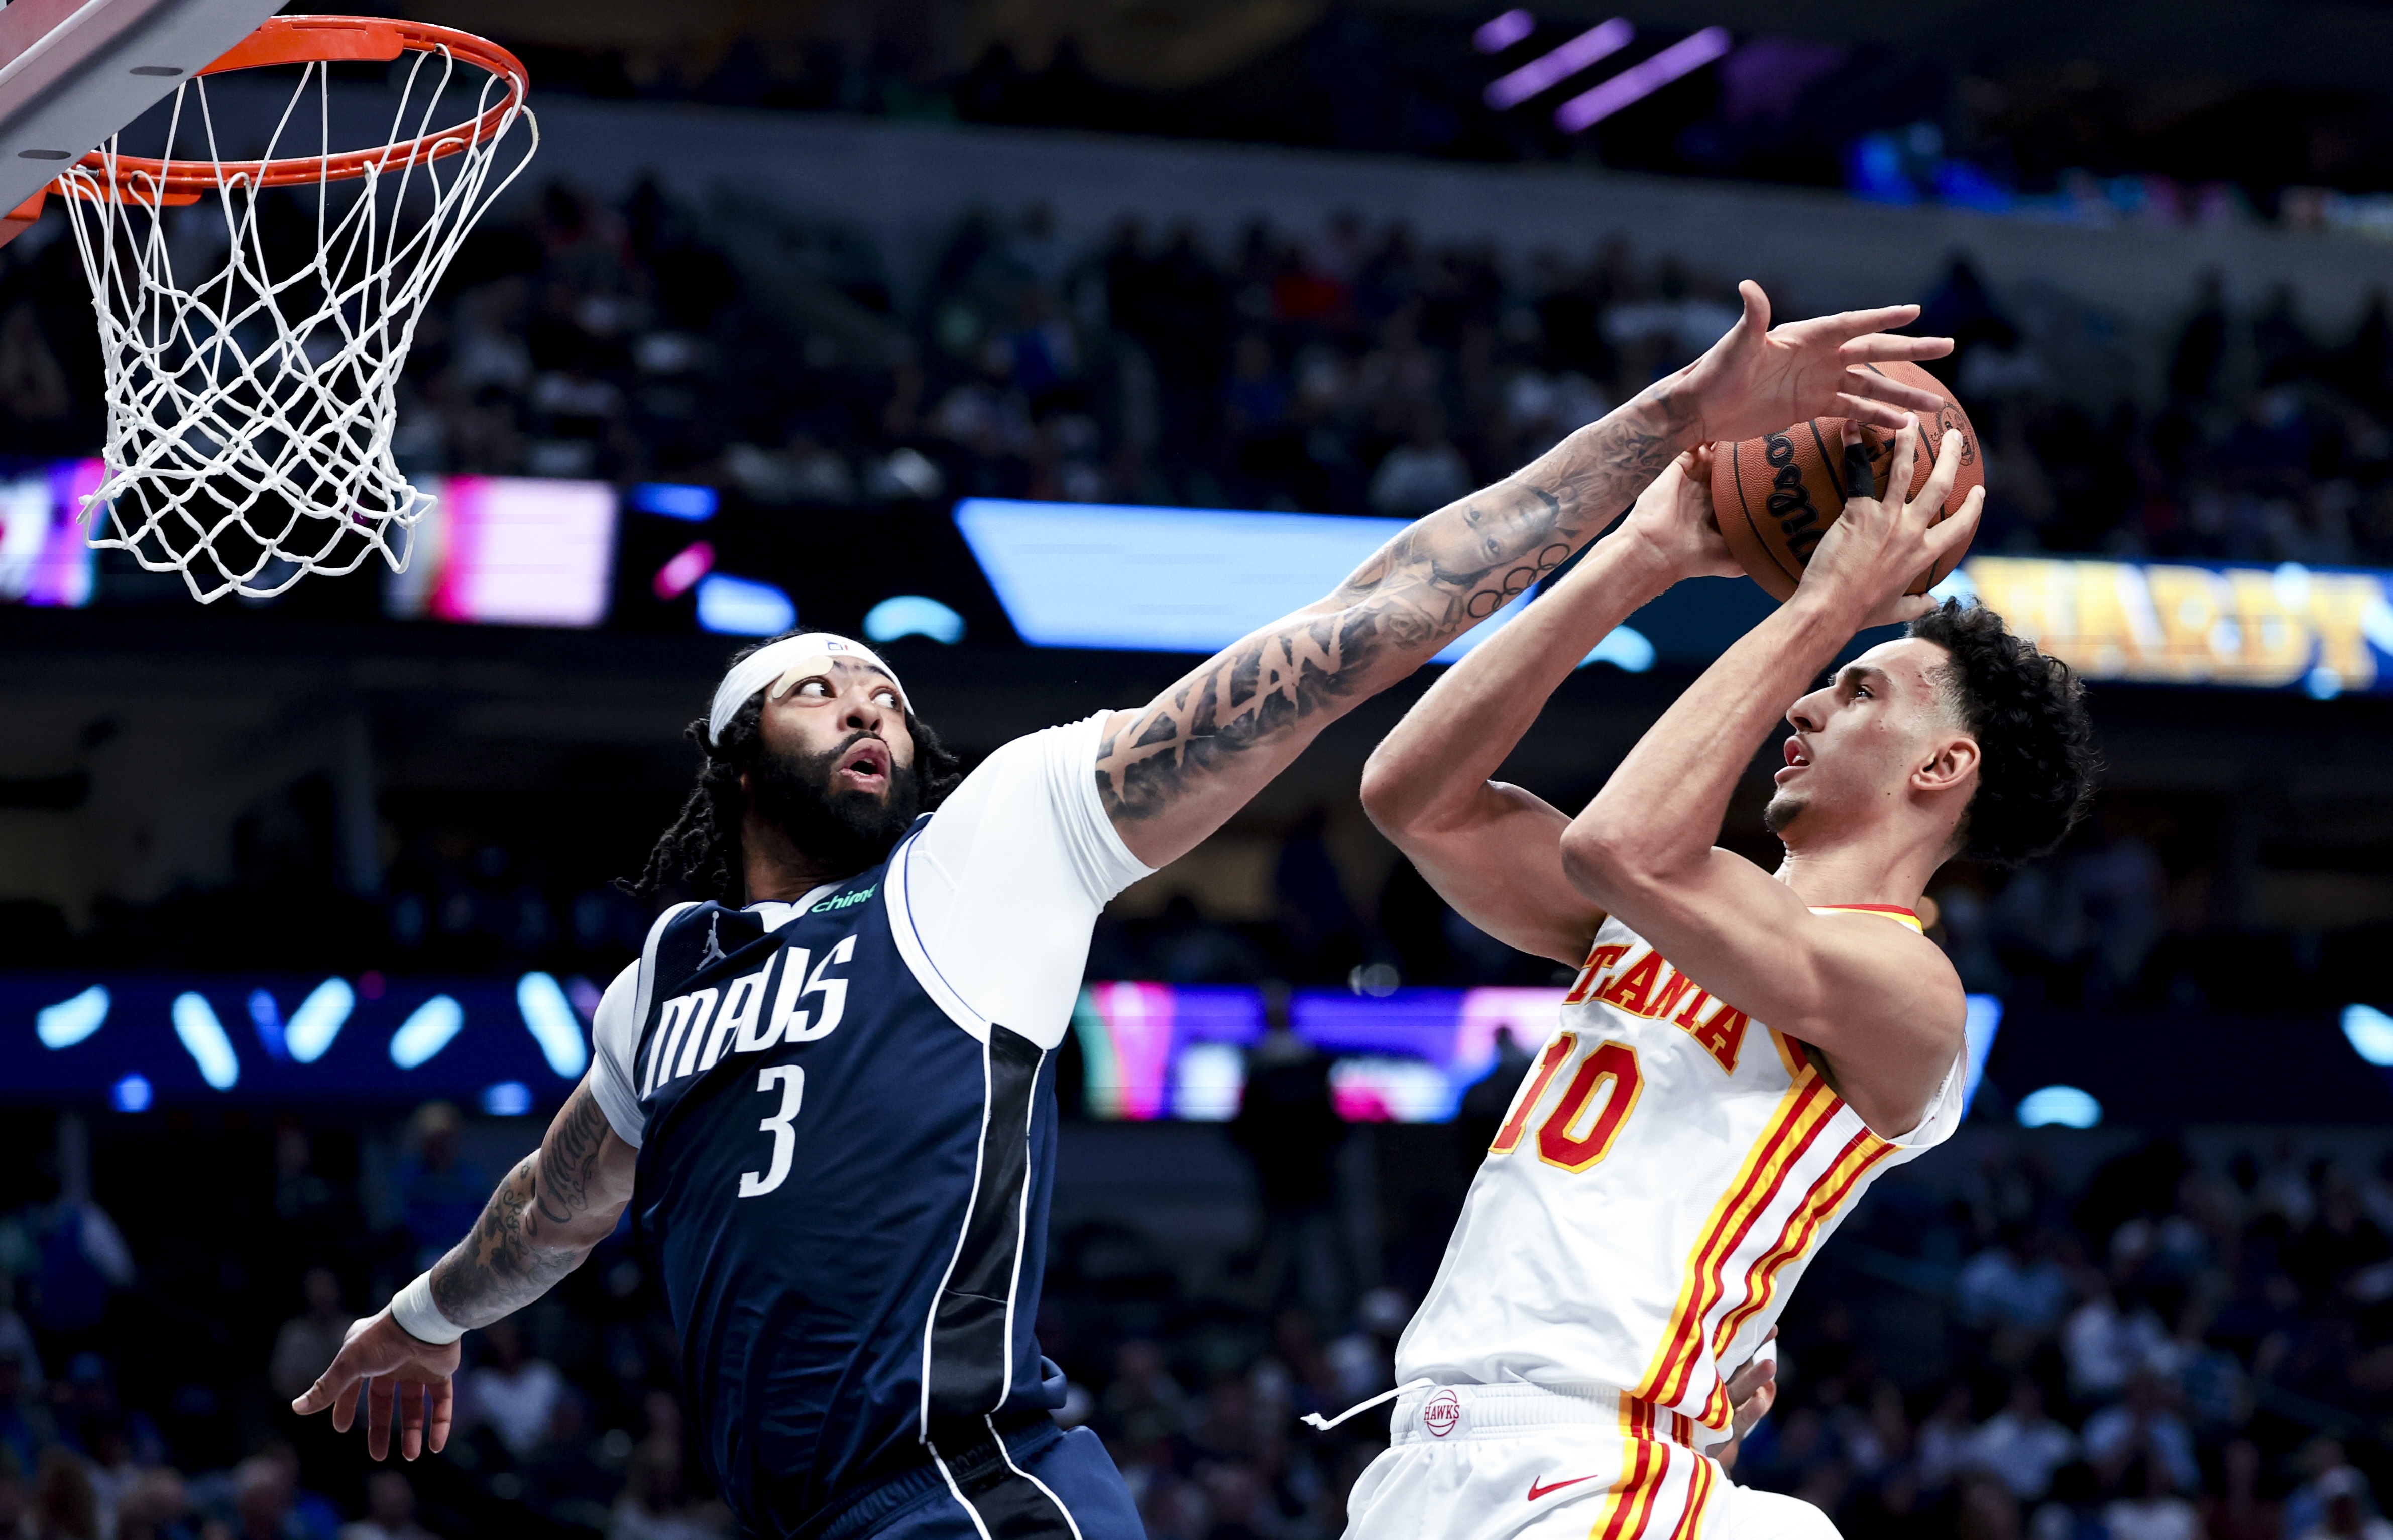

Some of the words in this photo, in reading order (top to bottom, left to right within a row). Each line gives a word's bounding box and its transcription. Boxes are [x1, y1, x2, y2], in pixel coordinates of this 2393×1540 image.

[1763, 427, 1827, 568] ilso
[1562, 942, 1751, 1077] TANTA
[738, 1064, 805, 1198] 3
[1488, 1031, 1645, 1174] 10
[1424, 1404, 1460, 1421] HAWKS
